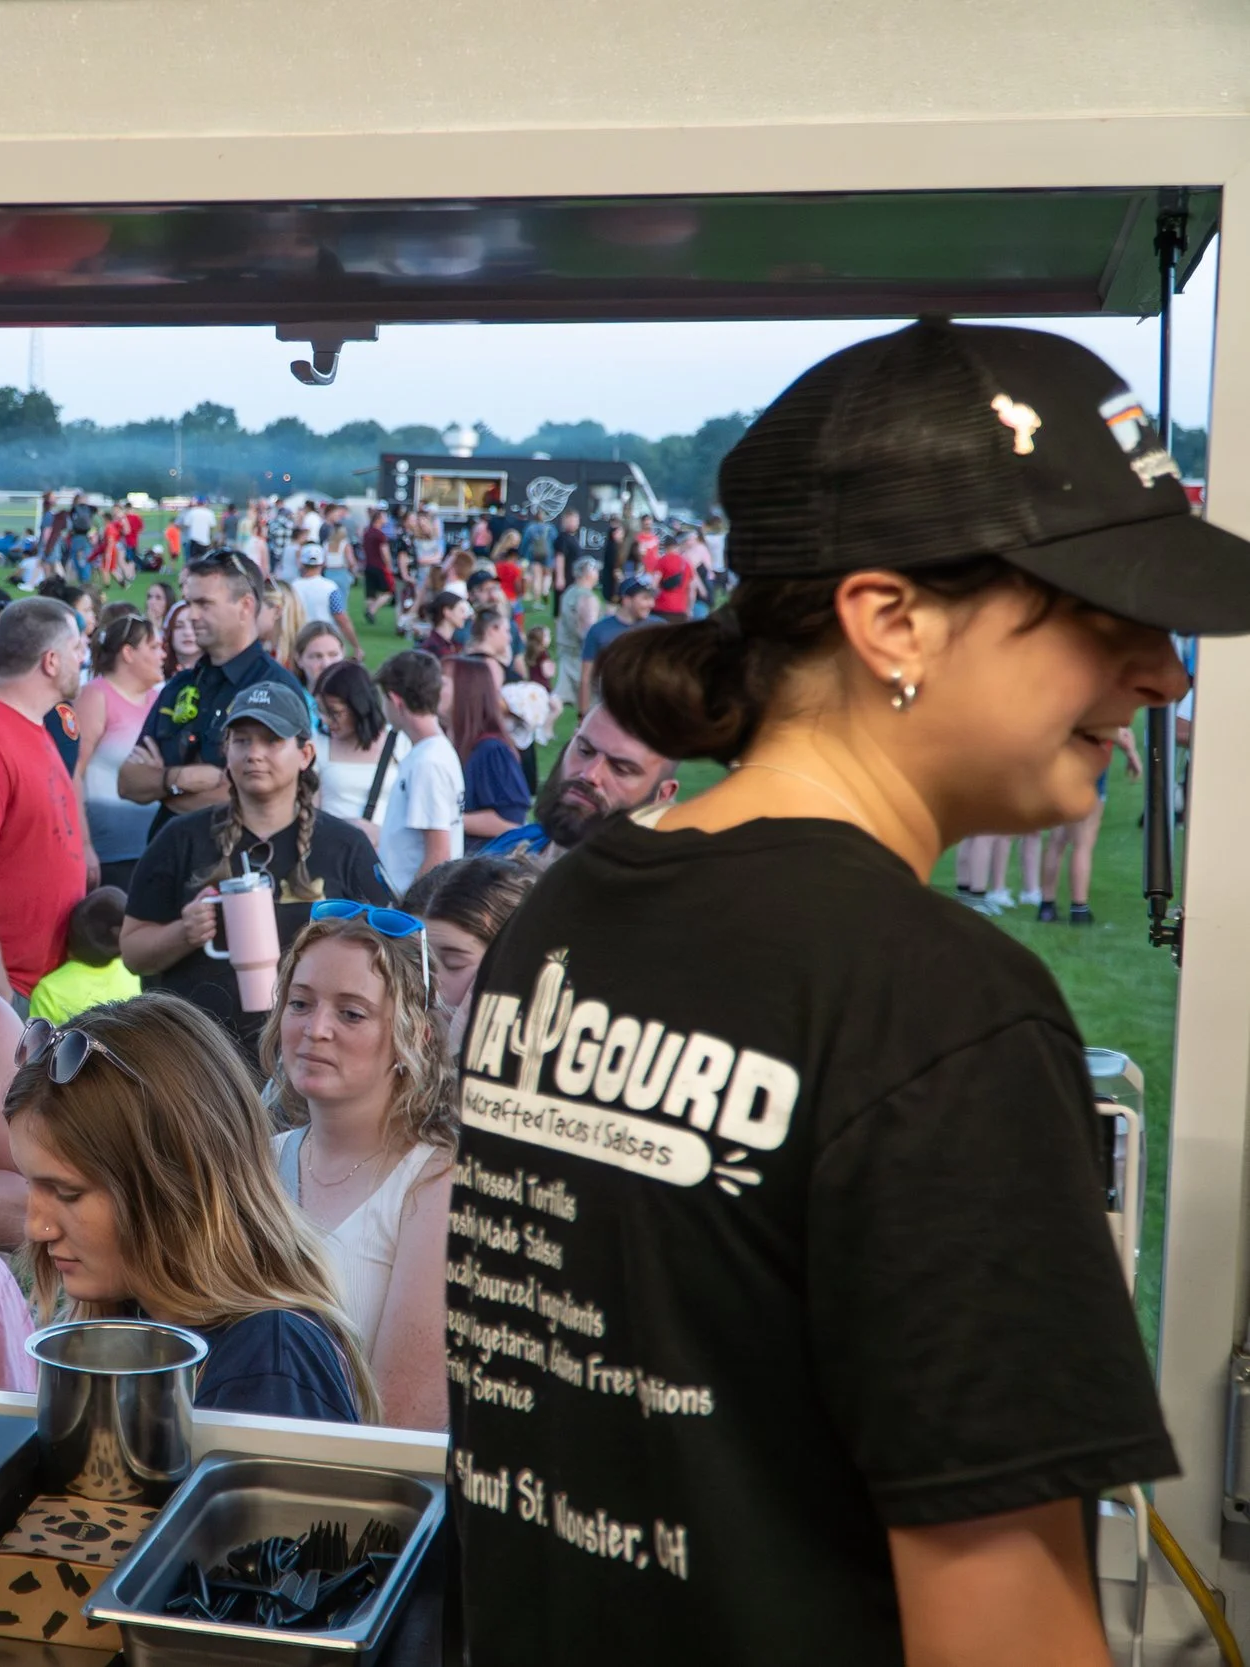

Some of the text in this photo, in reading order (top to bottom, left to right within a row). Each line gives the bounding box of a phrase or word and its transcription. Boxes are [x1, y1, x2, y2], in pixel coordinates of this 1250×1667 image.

[554, 1000, 800, 1151] GOURD
[602, 1122, 674, 1166] Salsas
[478, 1216, 520, 1254] Made
[473, 1363, 536, 1413] Service
[586, 1352, 636, 1396] Free
[517, 1468, 548, 1527] St.
[654, 1518, 688, 1581] OH
